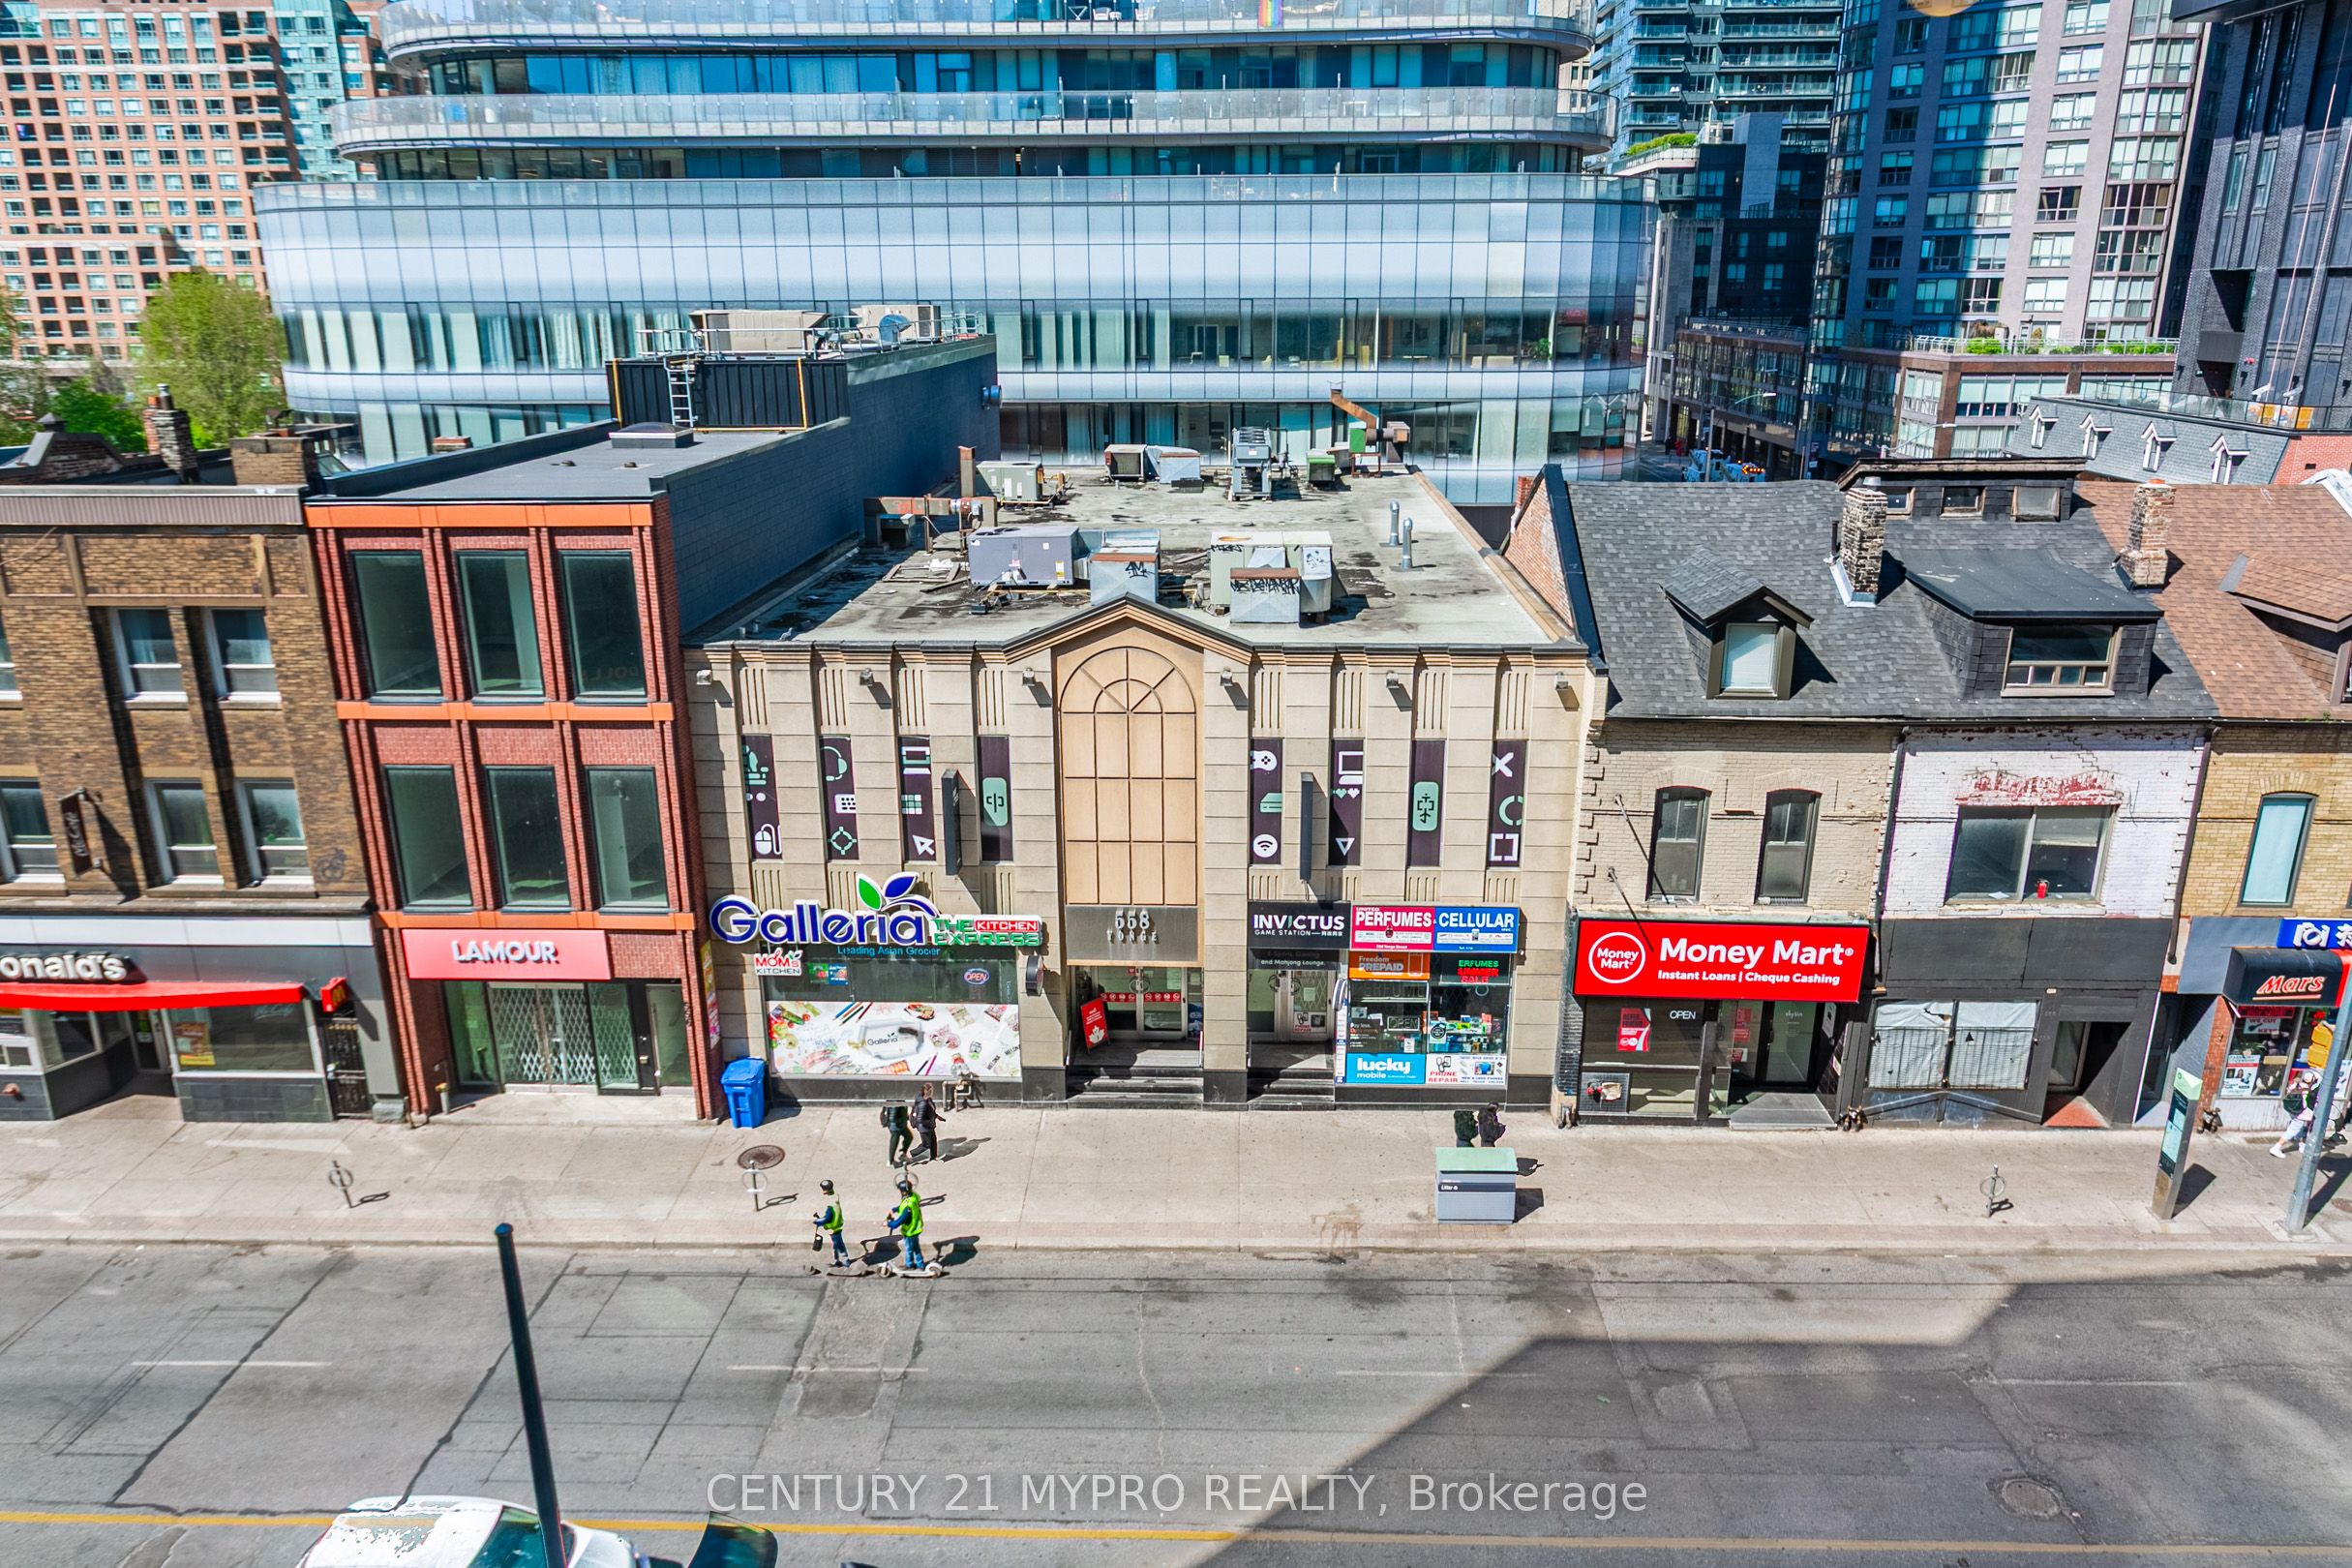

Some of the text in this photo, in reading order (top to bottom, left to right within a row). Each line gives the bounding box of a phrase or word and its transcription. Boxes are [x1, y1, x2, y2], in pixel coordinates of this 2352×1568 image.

[709, 894, 926, 947] Galleria
[931, 919, 1038, 931] THE KITCHEN
[1252, 915, 1344, 929] INVICTUS
[1355, 911, 1432, 927] PERFUMES
[1438, 913, 1515, 927] CELLULAR
[934, 932, 1040, 947] EXPRESS
[1106, 929, 1158, 942] YONGE
[451, 940, 558, 962] LAMOUR
[837, 946, 875, 956] Leading
[906, 947, 941, 955] Grocer
[1597, 948, 1639, 961] Money
[1659, 937, 1764, 969] Money
[1658, 970, 1701, 980] Instant
[1702, 971, 1736, 980] Loans
[1744, 972, 1791, 983] Cheque
[1793, 974, 1840, 985] Cashing
[2255, 975, 2326, 995] Mars
[1670, 1010, 1696, 1019] OPEN
[1391, 1016, 1419, 1028] OPEN
[867, 1036, 897, 1045] Galleria
[1357, 1057, 1410, 1074] lucky
